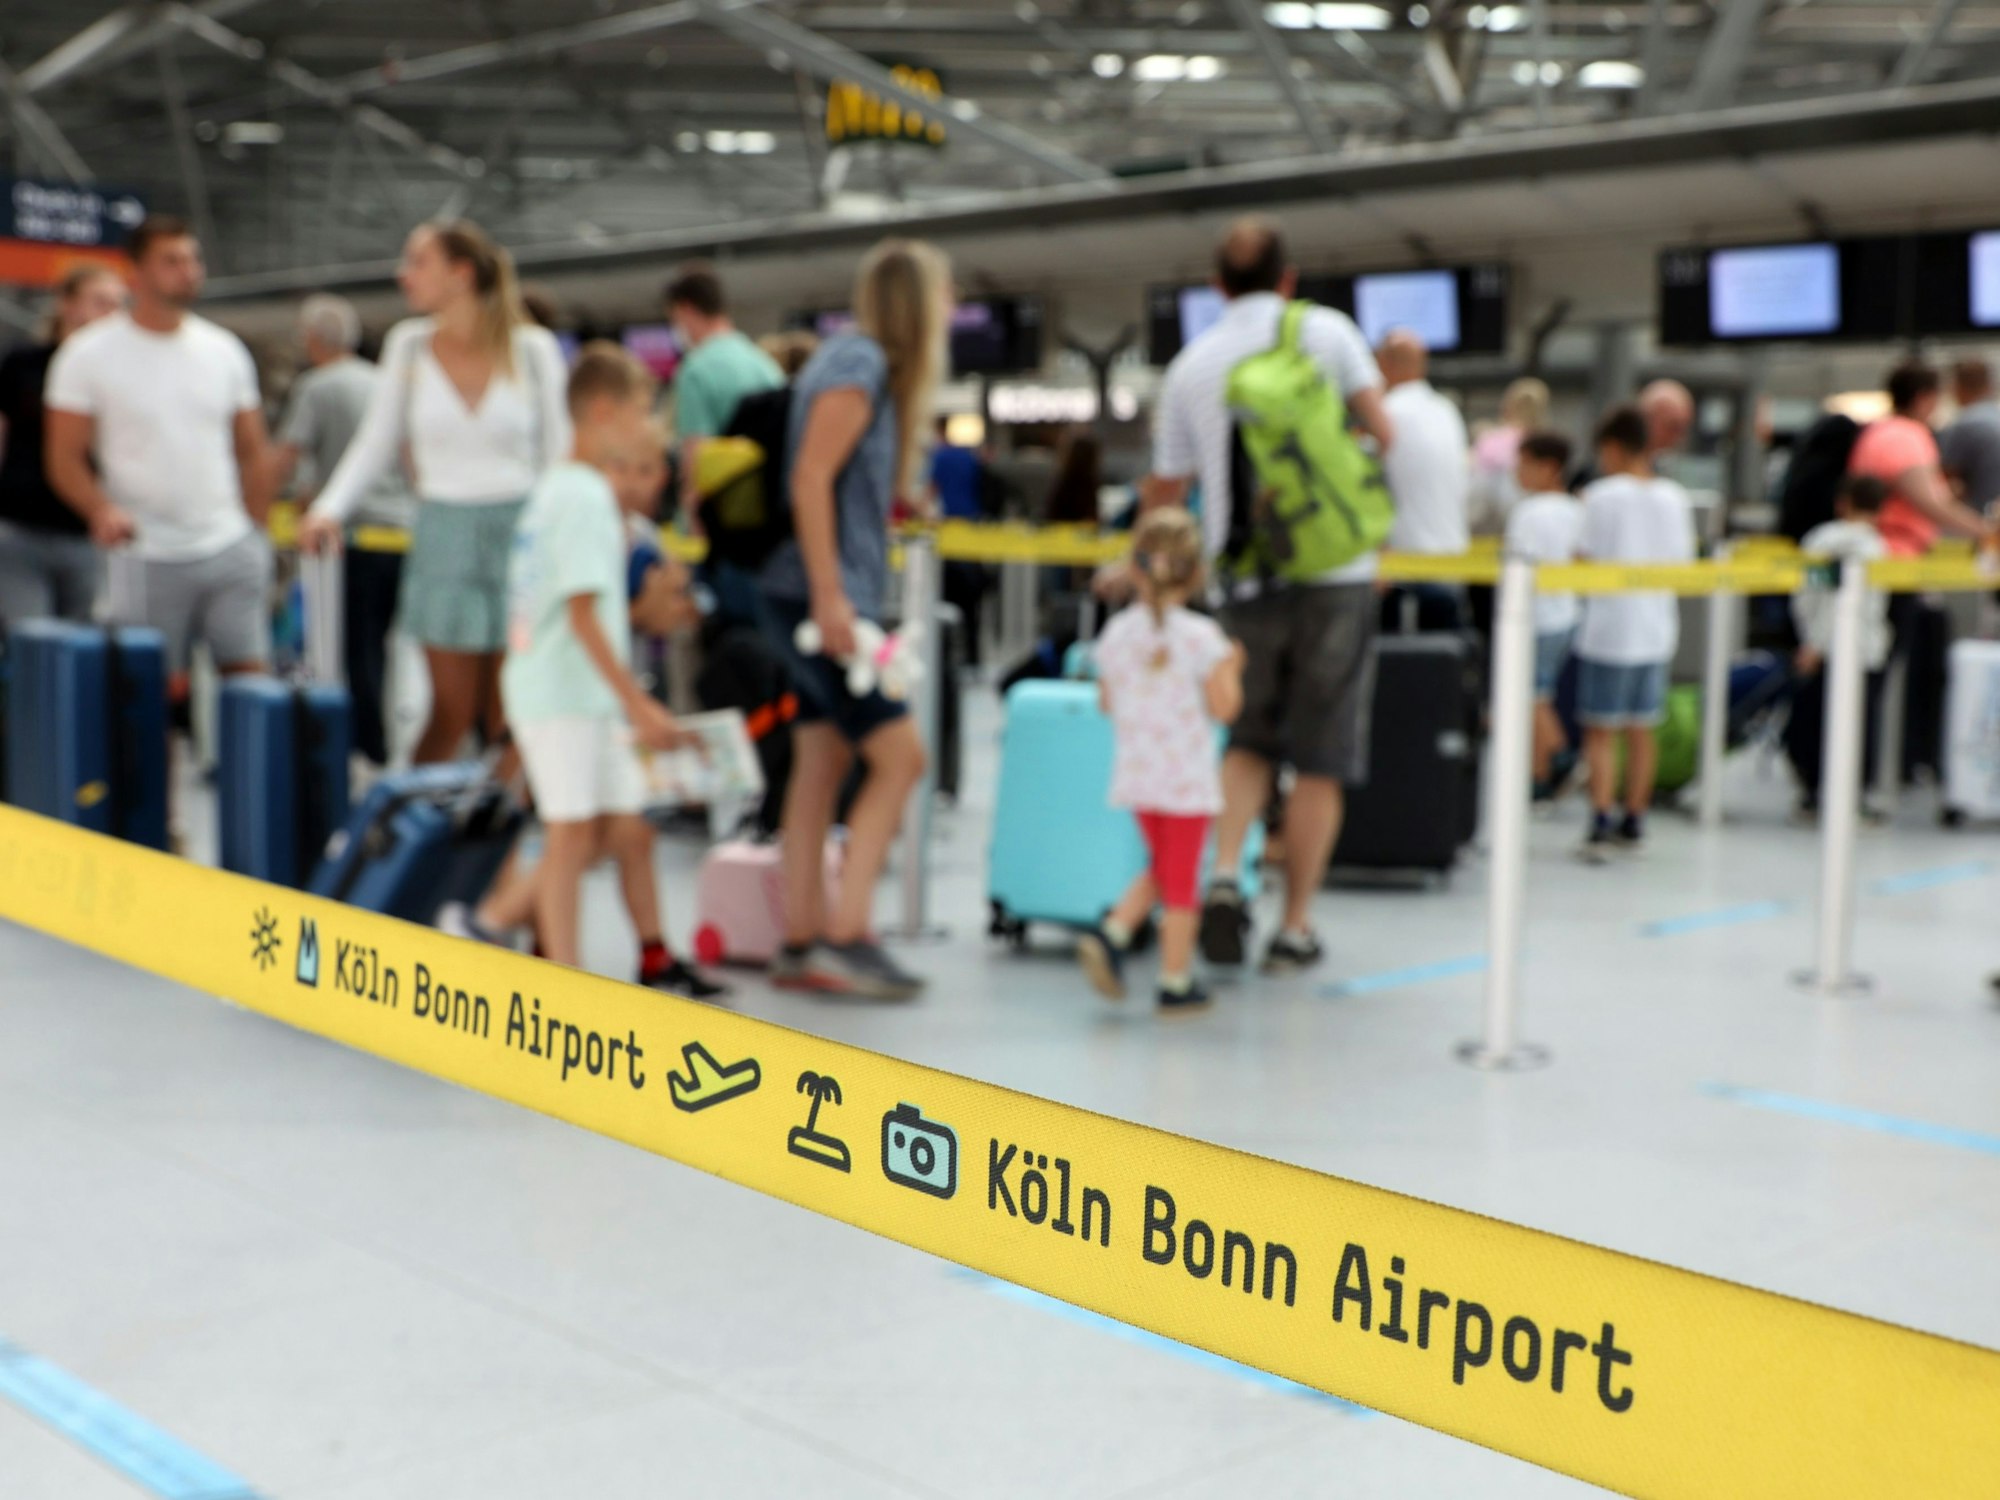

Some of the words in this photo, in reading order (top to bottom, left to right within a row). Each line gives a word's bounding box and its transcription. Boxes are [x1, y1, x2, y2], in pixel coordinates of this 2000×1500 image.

[335, 939, 399, 1008] Köln
[413, 962, 491, 1038] Bonn
[506, 992, 647, 1090] Airport
[988, 1138, 1111, 1248] Köln
[1142, 1184, 1297, 1307] Bonn
[1332, 1242, 1634, 1413] Airport
